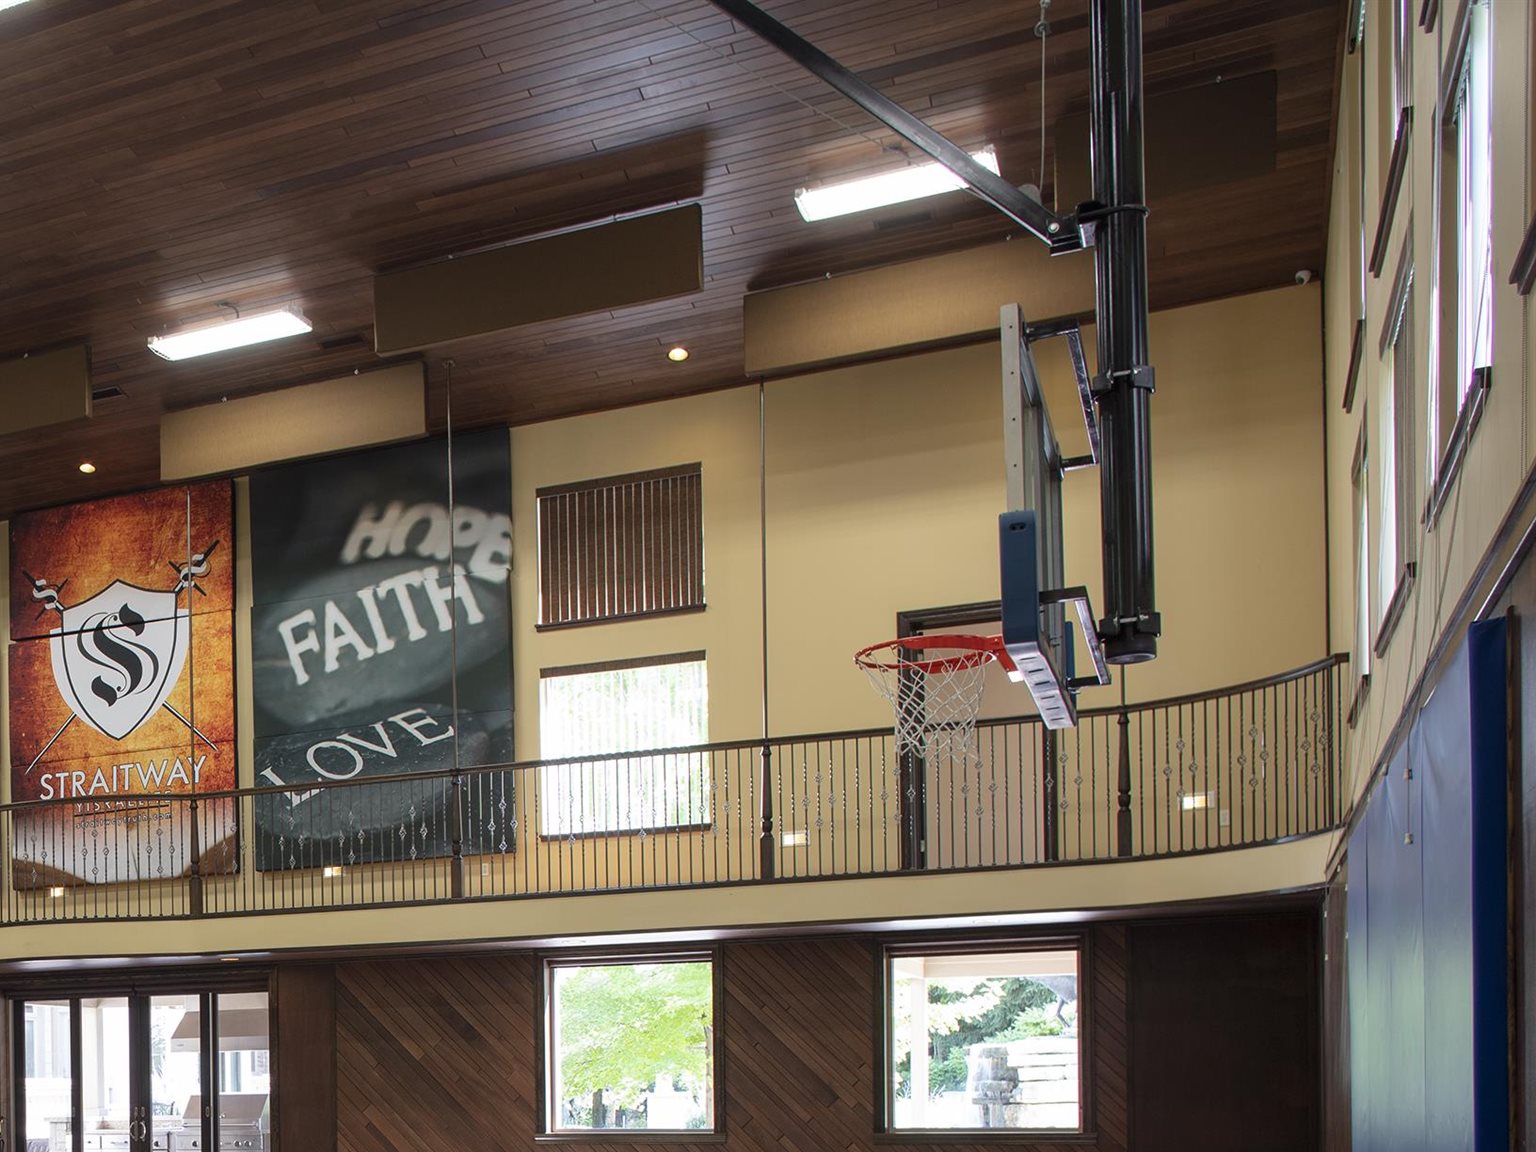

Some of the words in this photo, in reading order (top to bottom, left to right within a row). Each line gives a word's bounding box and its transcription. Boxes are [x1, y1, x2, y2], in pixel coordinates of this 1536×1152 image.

[340, 500, 512, 584] HOPE
[278, 563, 485, 685] FAITH
[39, 755, 207, 801] STRAITWAY
[260, 706, 455, 809] LOVE
